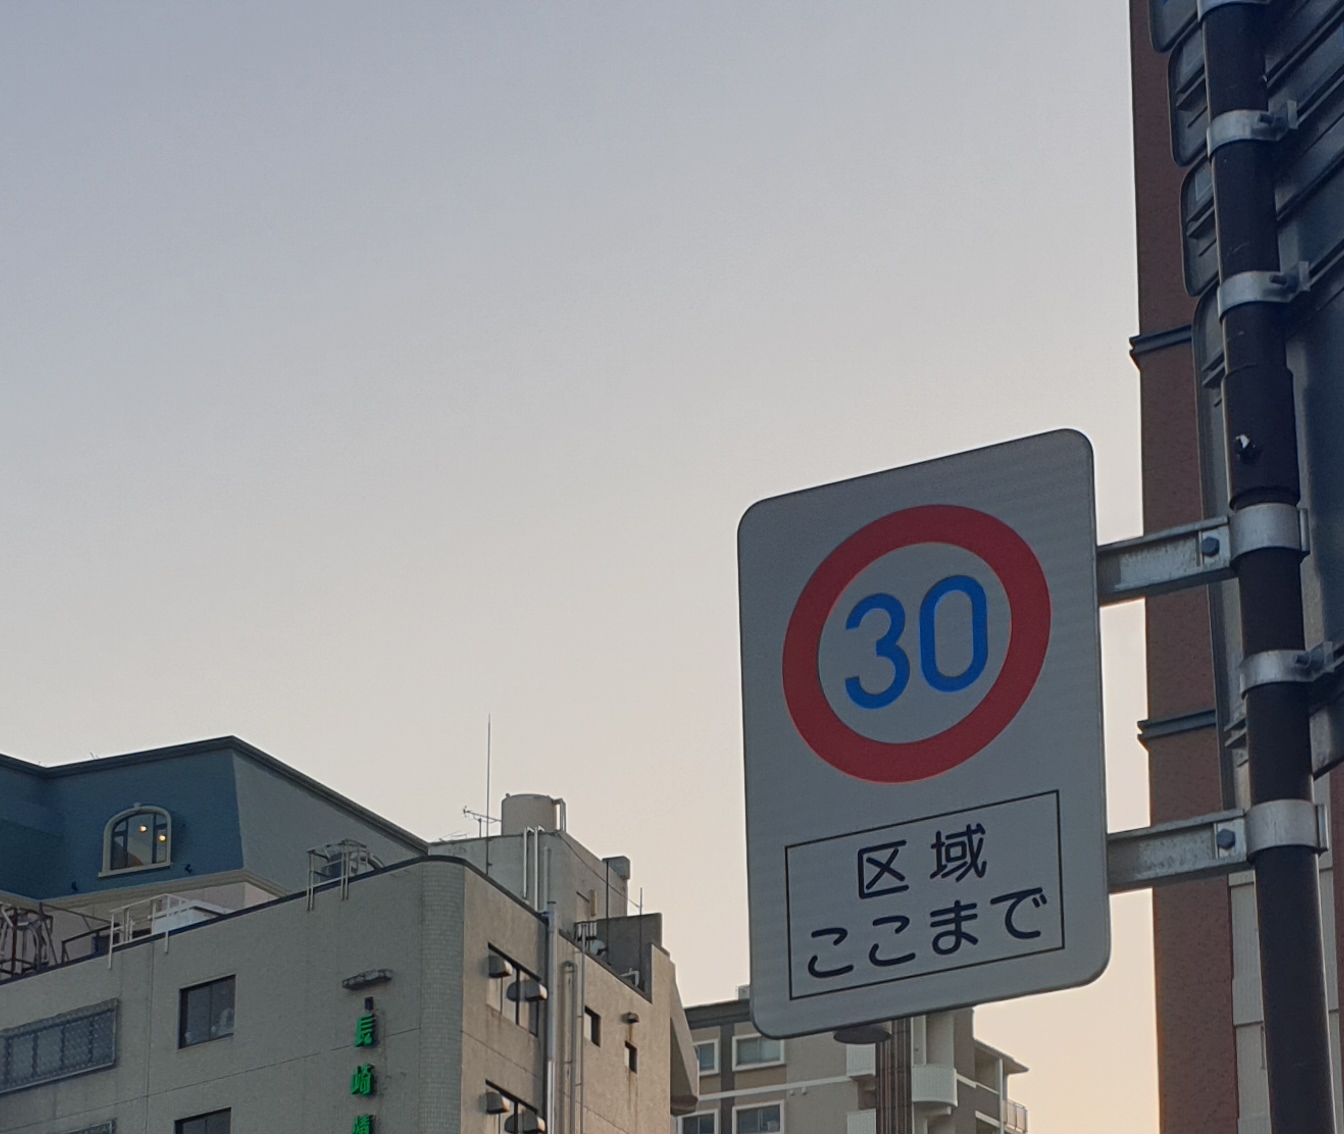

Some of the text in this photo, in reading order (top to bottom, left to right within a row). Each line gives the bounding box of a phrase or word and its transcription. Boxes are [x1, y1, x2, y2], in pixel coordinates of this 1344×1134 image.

[844, 574, 989, 711] 30
[857, 821, 988, 900] 区域
[807, 885, 1049, 979] ここまで
